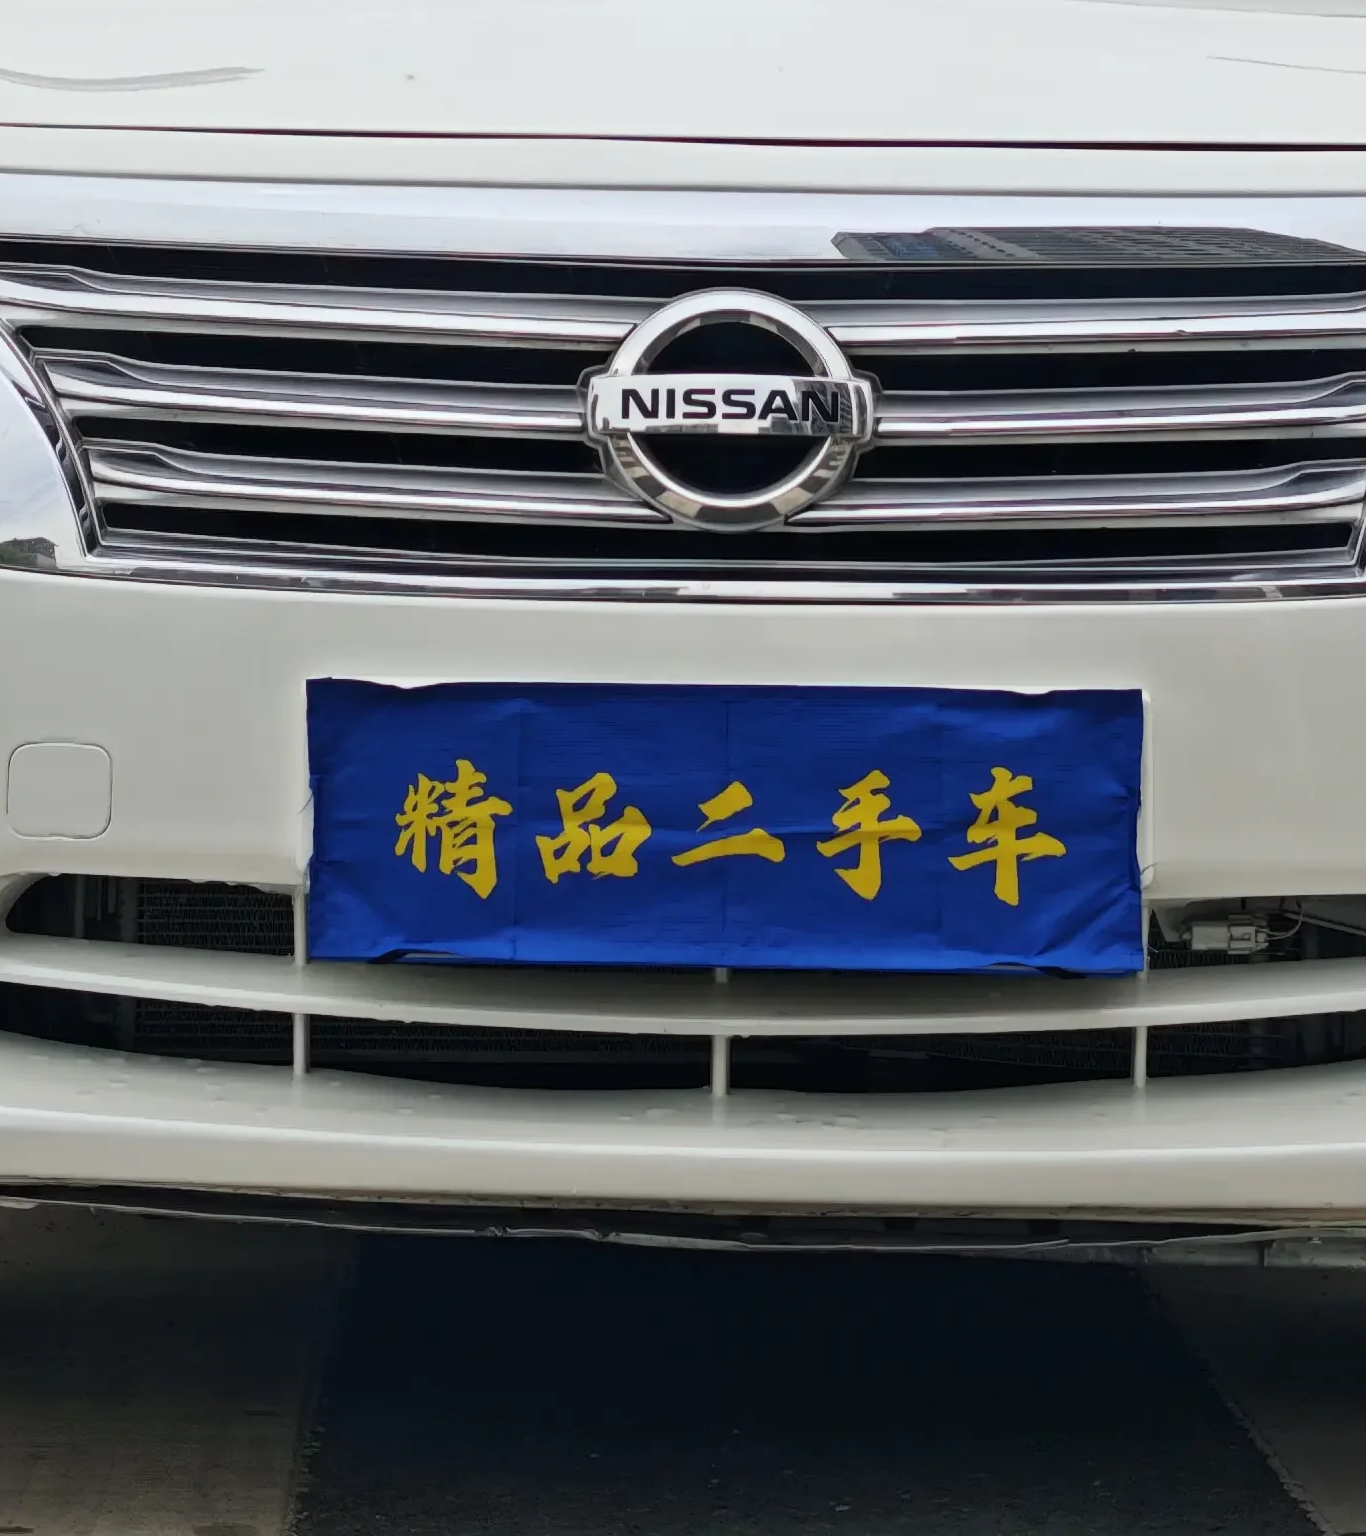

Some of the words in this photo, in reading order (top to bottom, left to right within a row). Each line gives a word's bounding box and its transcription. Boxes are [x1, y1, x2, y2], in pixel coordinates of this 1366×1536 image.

[621, 388, 839, 422] NISSAN
[395, 758, 1067, 906] 精品二手车
